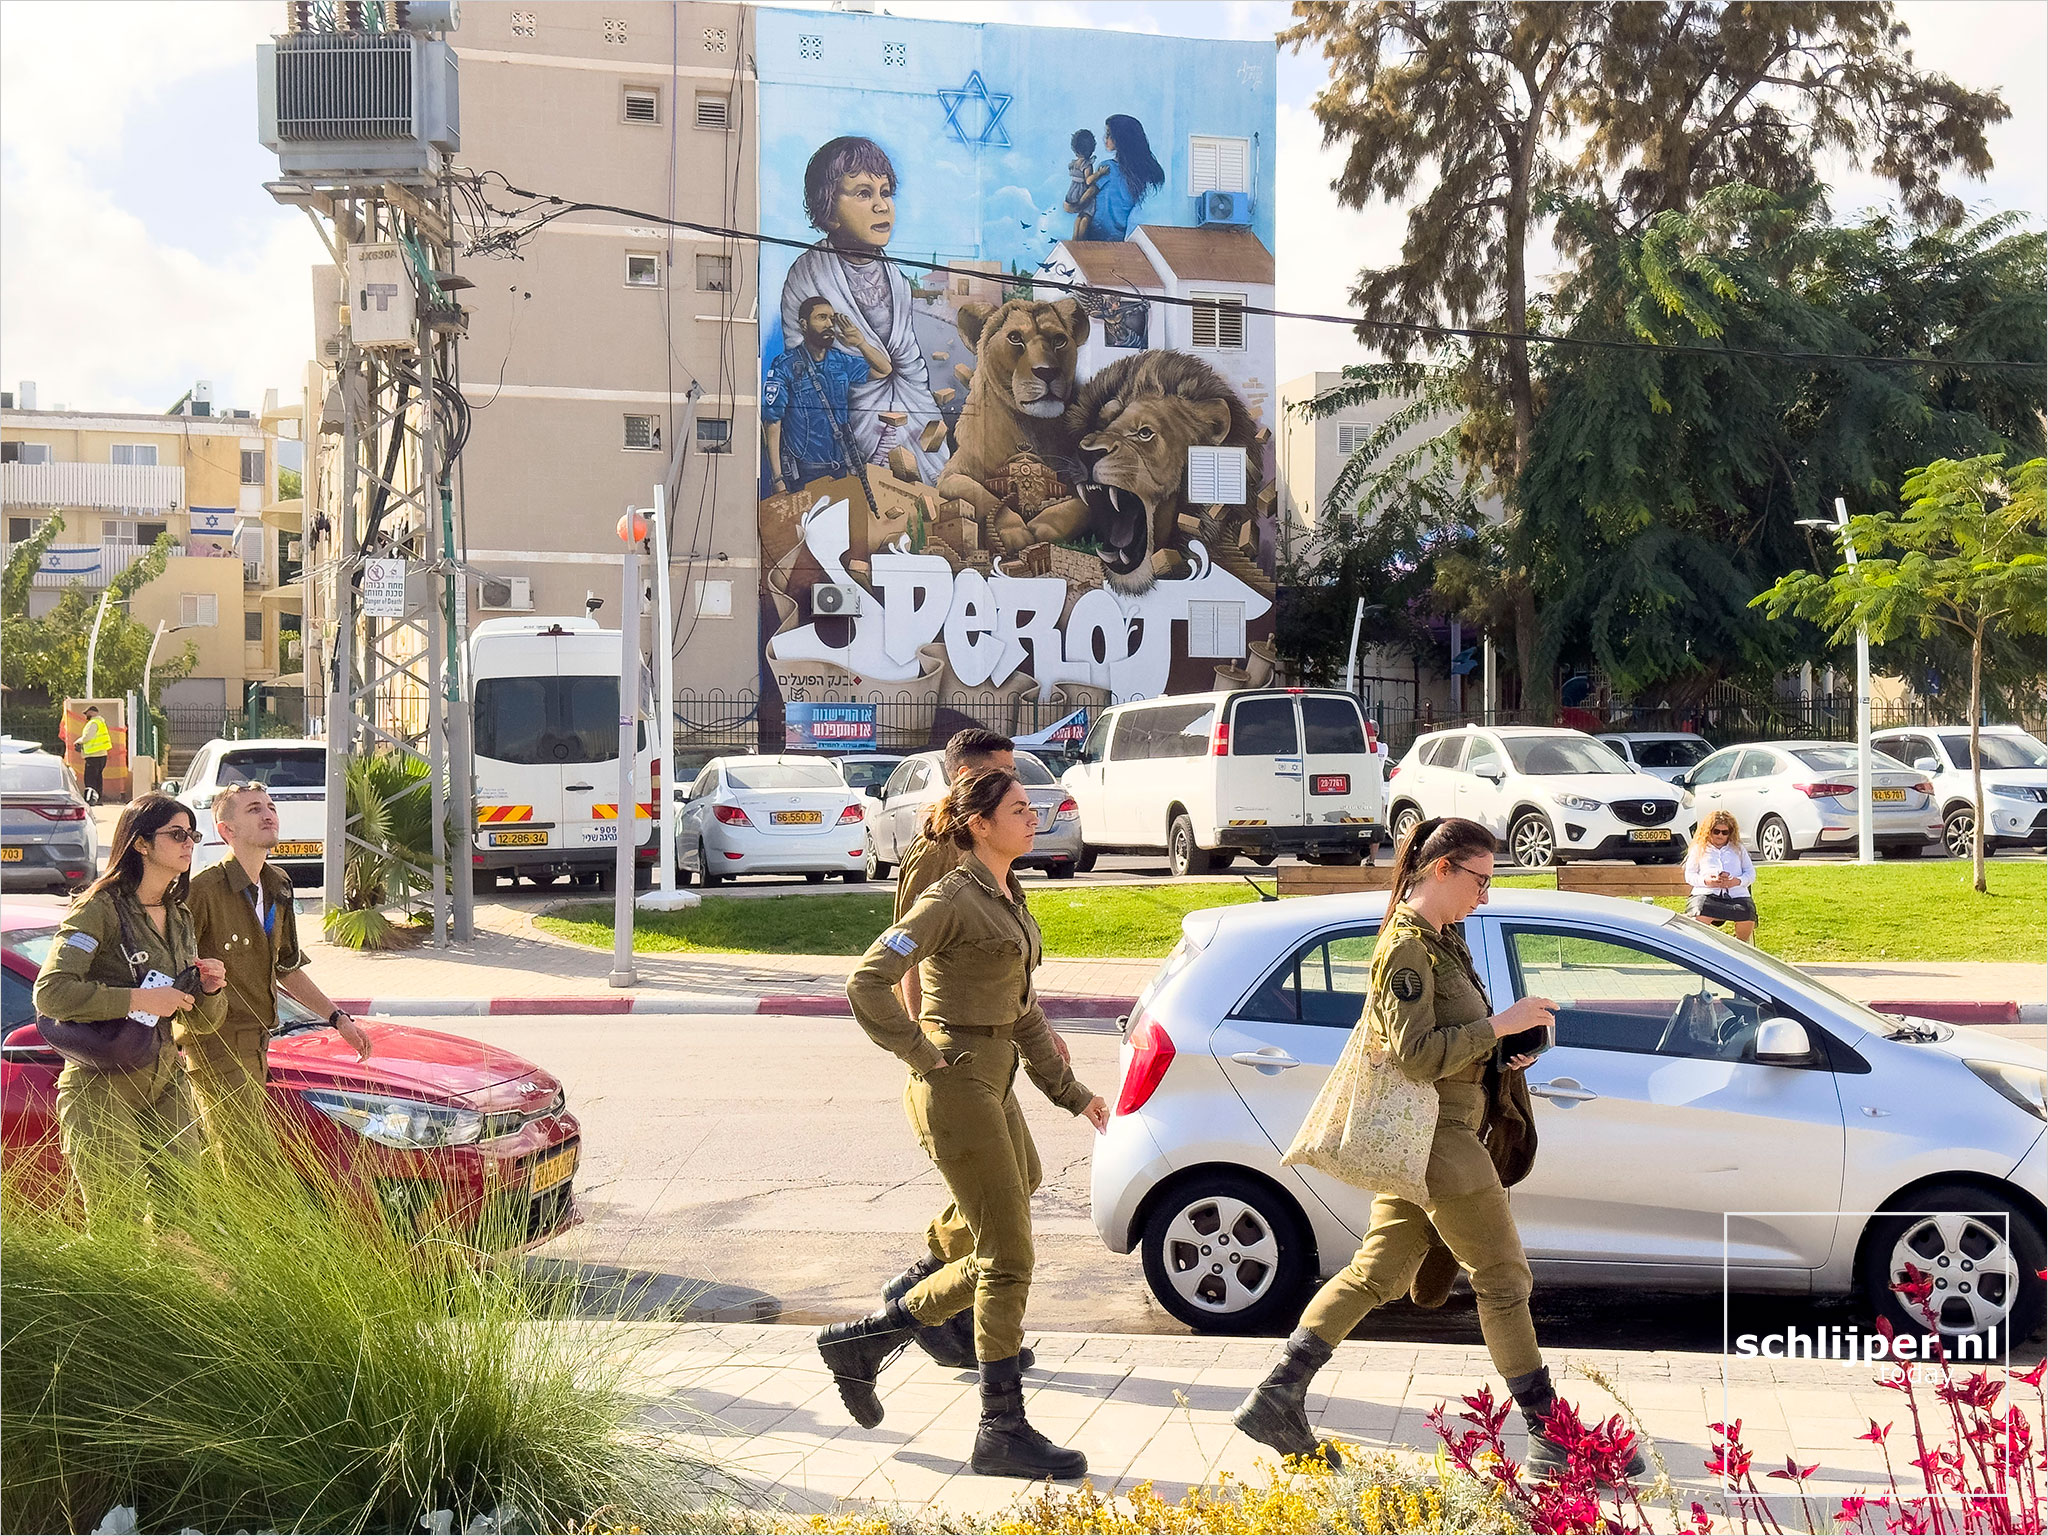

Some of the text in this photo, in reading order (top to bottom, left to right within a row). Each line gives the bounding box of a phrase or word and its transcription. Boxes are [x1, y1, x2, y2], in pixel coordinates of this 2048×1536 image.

[365, 597, 381, 606] Danger
[778, 673, 824, 687] הפועלים
[861, 708, 872, 722] או
[860, 723, 871, 737] או
[2, 849, 19, 859] 703
